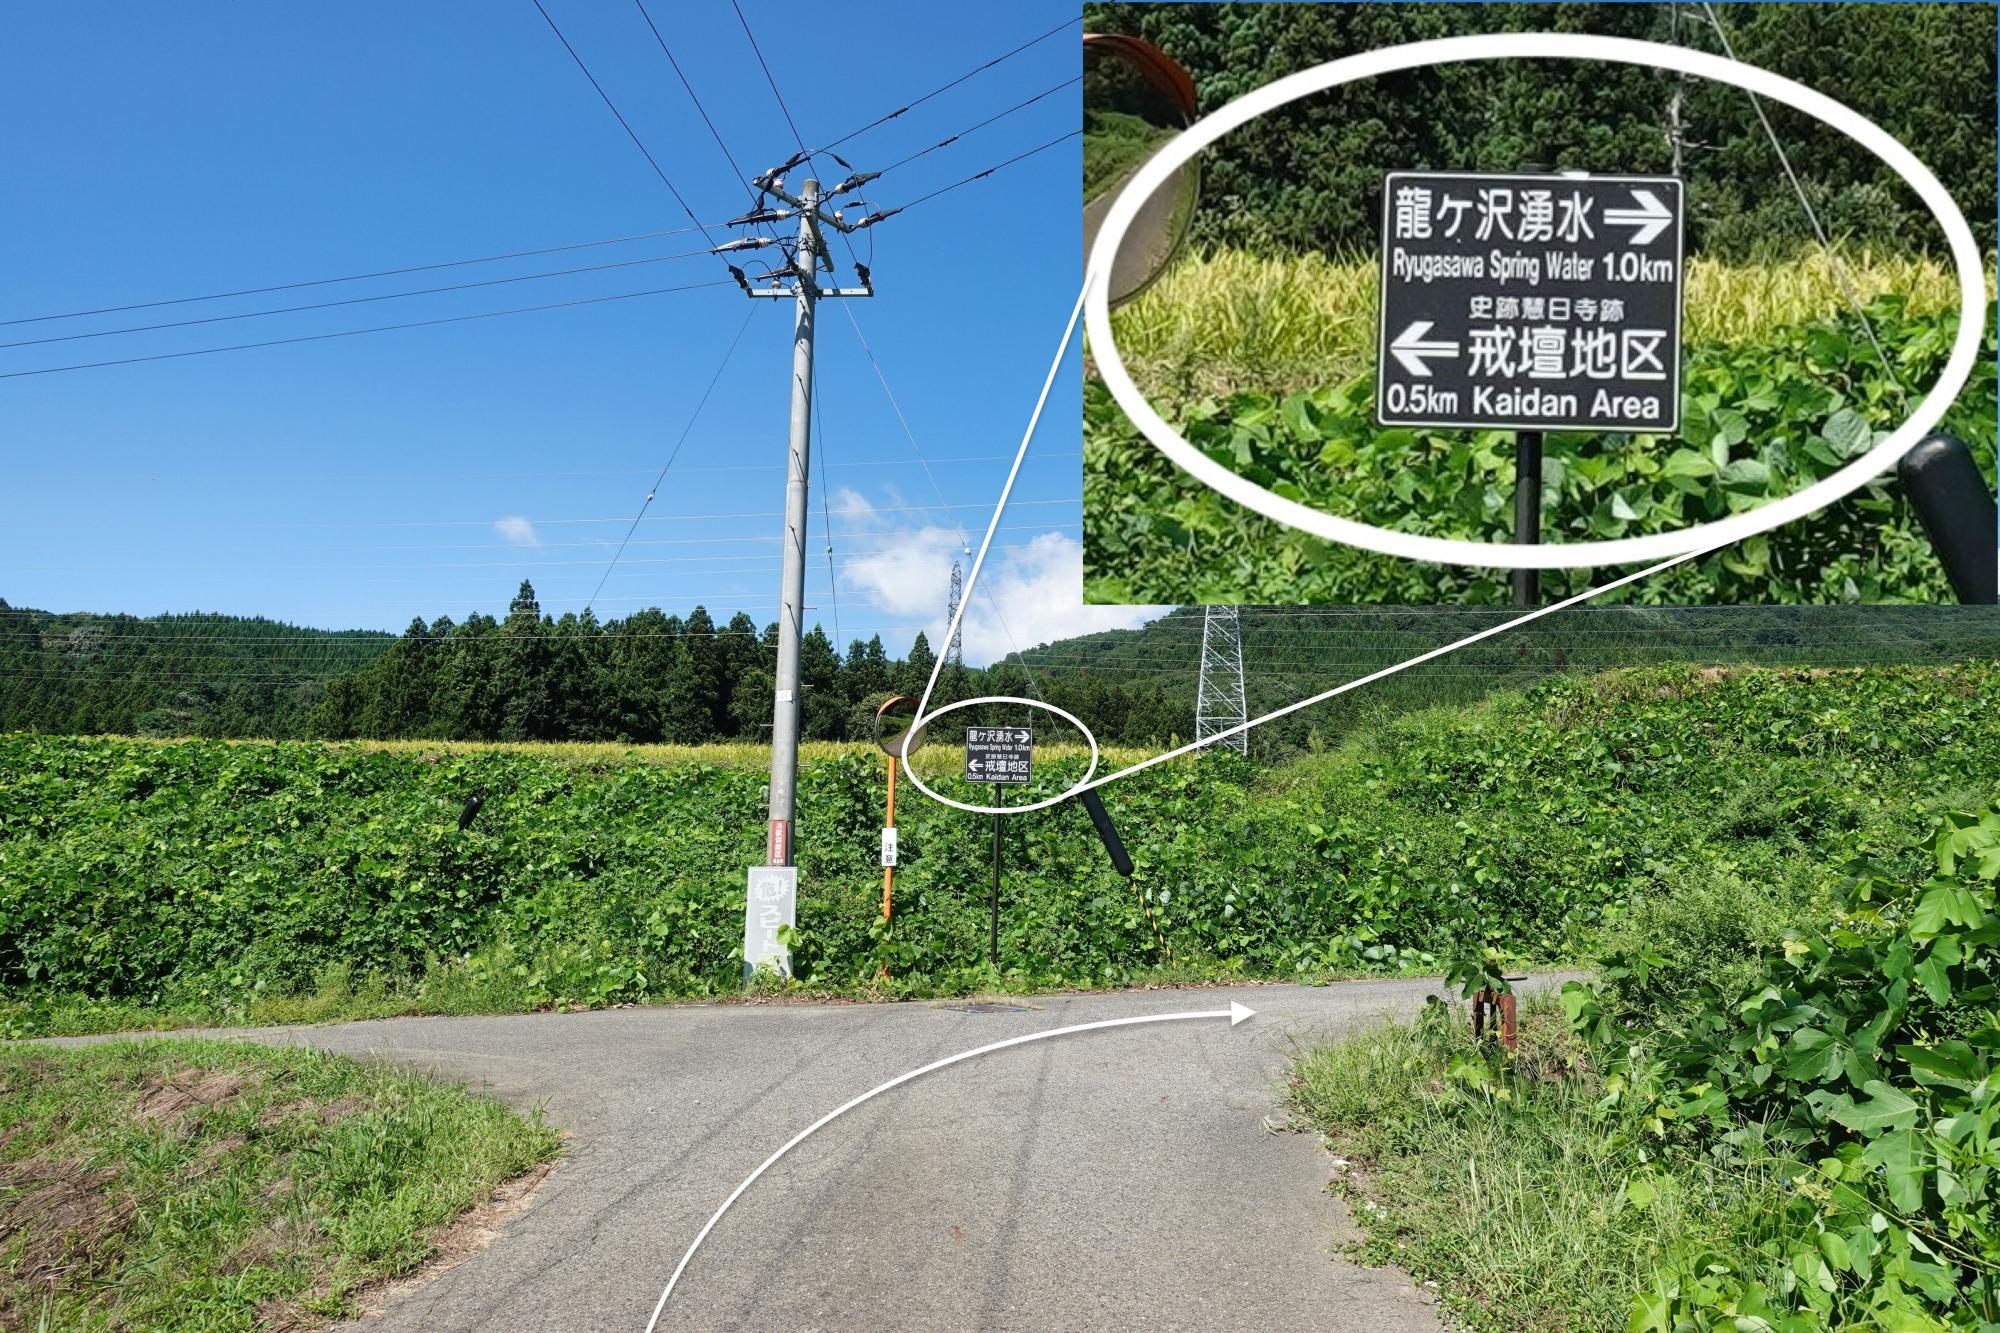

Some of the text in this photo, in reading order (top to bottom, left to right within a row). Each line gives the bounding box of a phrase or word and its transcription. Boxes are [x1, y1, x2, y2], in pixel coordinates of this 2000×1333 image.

[1393, 247, 1673, 285] Ryugasawa Spring Water 1.0km
[1469, 296, 1624, 322] 史跡慧日寺跡
[1468, 324, 1667, 381] 戒壇地区
[1387, 383, 1660, 419] 0.5km Kaidan Area
[985, 760, 1029, 772] 戒壇地区
[884, 842, 894, 863] 注意
